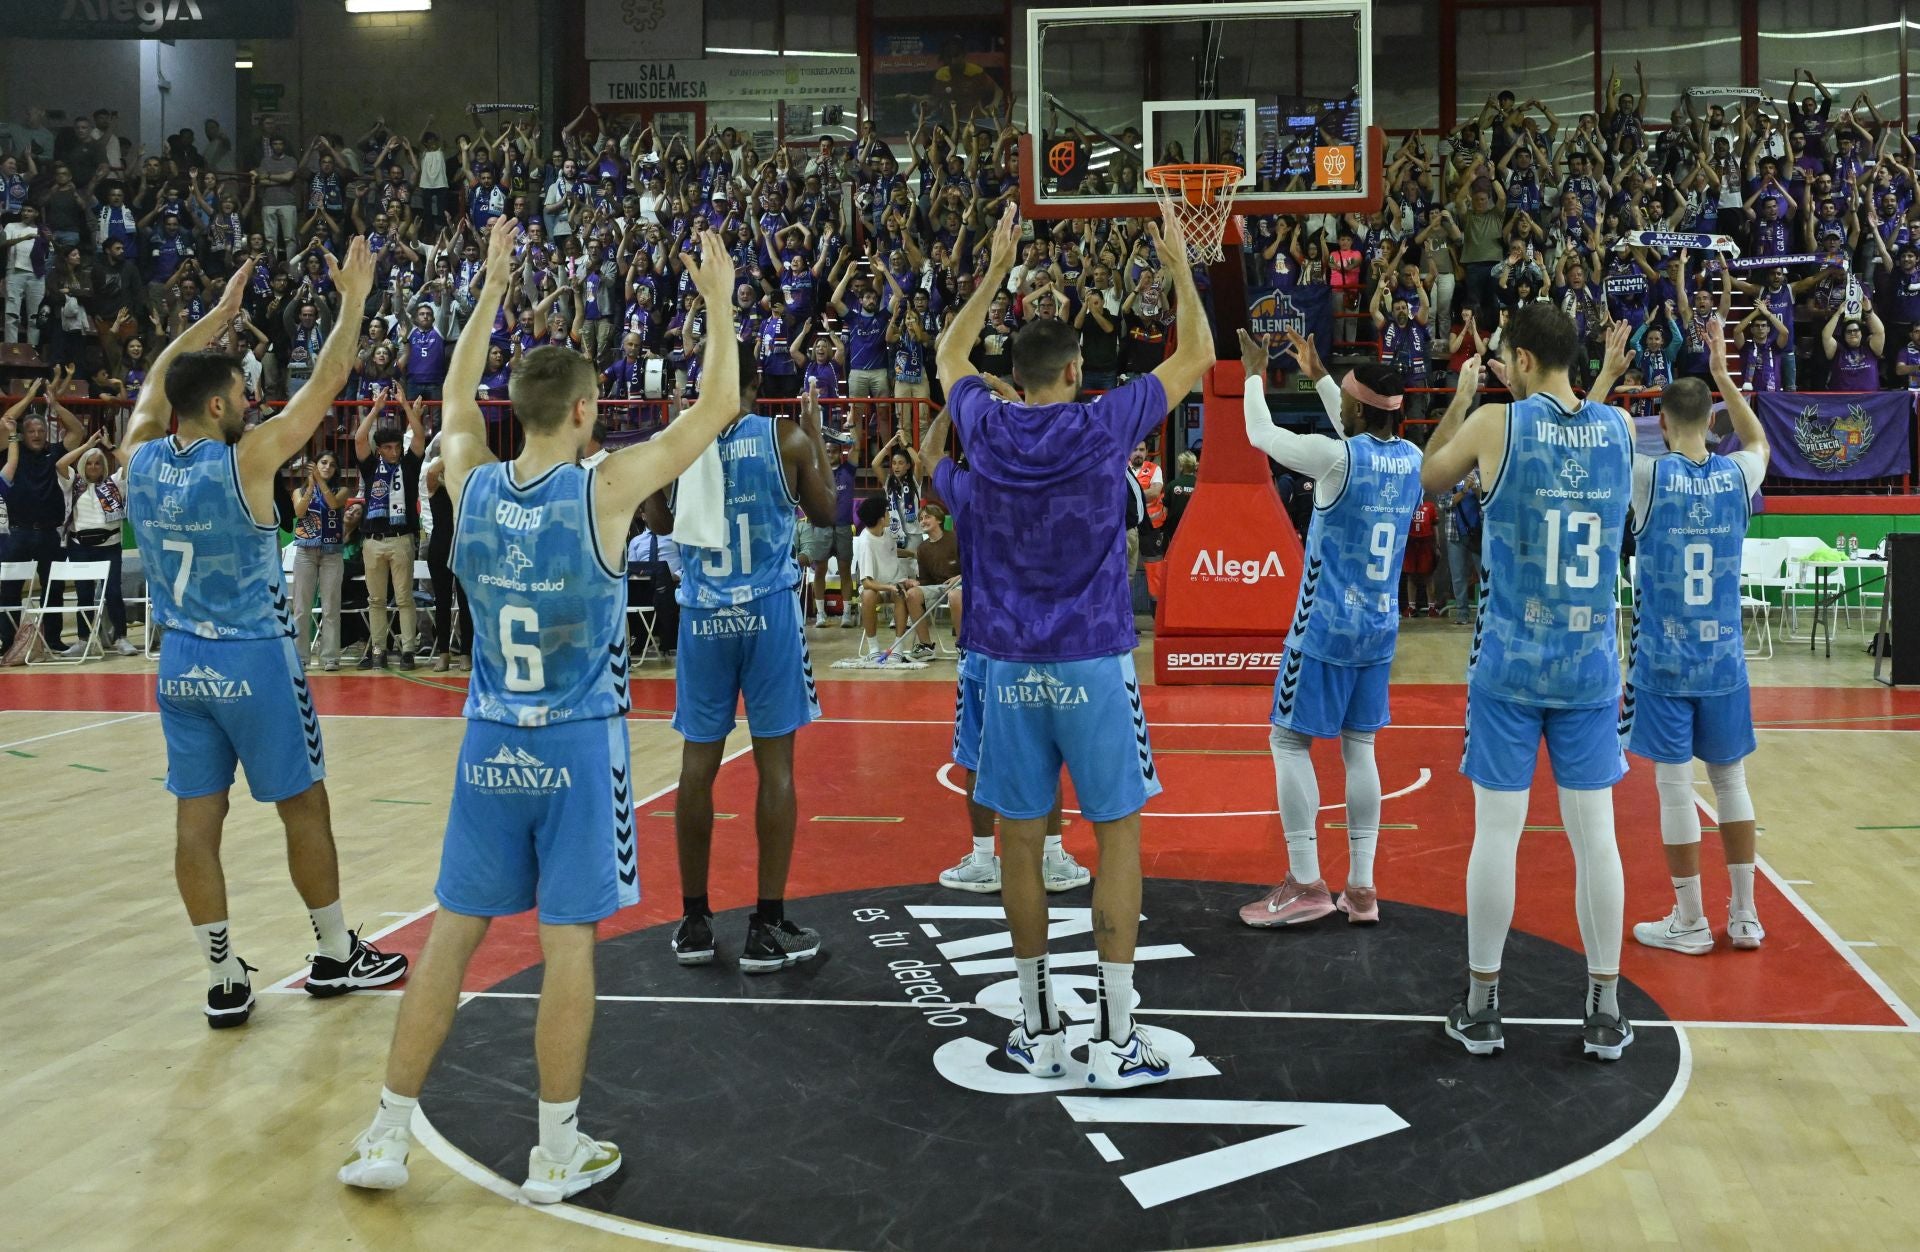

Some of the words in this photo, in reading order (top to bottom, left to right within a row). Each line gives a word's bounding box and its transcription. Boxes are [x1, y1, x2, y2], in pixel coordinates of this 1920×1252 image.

[640, 64, 675, 81] SALA
[1650, 239, 1702, 248] PALENCIA
[1655, 233, 1699, 241] BASKET
[1732, 256, 1816, 267] VOLVEREMOS
[1252, 319, 1301, 333] ALENCIA
[421, 347, 428, 357] 5
[1299, 381, 1317, 389] SALI
[1806, 440, 1840, 452] PALENCIA
[735, 493, 756, 504] salud
[1536, 488, 1584, 499] recoletas
[1587, 488, 1611, 499] salud
[1361, 505, 1394, 513] recoletas
[185, 520, 212, 532] salud
[1668, 526, 1708, 535] recoletas
[1710, 524, 1731, 534] salud
[1366, 522, 1396, 581] 9
[1544, 510, 1601, 588] 13
[162, 540, 194, 607] 7
[1190, 549, 1285, 584] AlegA
[1684, 543, 1713, 605] 8
[478, 574, 527, 591] recoletas
[531, 578, 564, 591] salud
[218, 627, 239, 635] Dip
[692, 615, 767, 636] LEBANZA
[1720, 625, 1734, 635] Dip
[499, 604, 545, 692] 6
[1167, 652, 1283, 669] SPORTSYSTE
[159, 678, 252, 698] LEBANZA
[997, 685, 1089, 705] LEBANZA
[550, 708, 573, 720] Dip
[465, 762, 572, 788] LEBANZA
[852, 907, 890, 922] es
[869, 930, 910, 948] tu
[887, 959, 968, 1027] derecho
